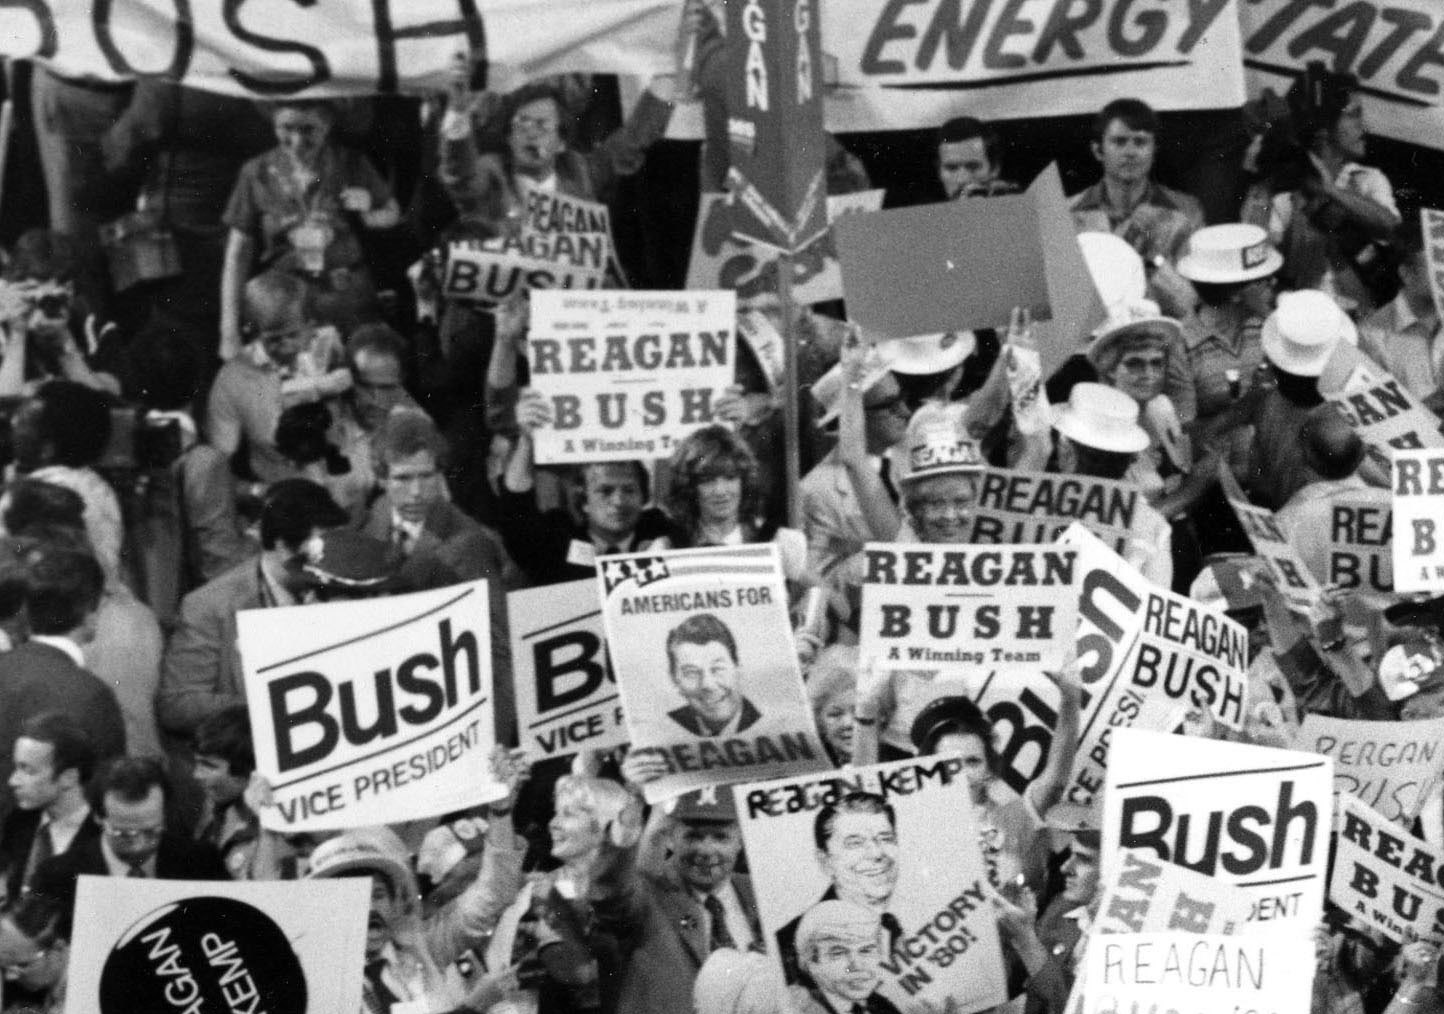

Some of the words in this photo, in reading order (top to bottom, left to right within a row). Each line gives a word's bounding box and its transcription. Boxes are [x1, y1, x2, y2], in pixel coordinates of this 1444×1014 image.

[530, 331, 730, 374] REAGAN
[551, 388, 714, 430] BUSH
[979, 472, 1138, 529] REAGAN
[866, 551, 1078, 586] REAGAN
[620, 589, 733, 615] AMERICANS
[735, 586, 773, 606] FOR
[879, 605, 1055, 639] BUSH
[1144, 592, 1247, 674] REAGAN
[887, 648, 900, 660] A
[908, 648, 985, 664] Winning
[991, 649, 1041, 662] Team
[267, 618, 482, 773] Bush
[1132, 643, 1245, 724] BUSH
[535, 713, 605, 754] VICE
[277, 784, 347, 823] VICE
[353, 719, 481, 801] PRESIDENT
[878, 759, 962, 796] KEMP
[1119, 780, 1319, 878] Bush
[880, 881, 988, 976] VICTORY
[1355, 901, 1366, 914] A
[899, 974, 932, 996] IN
[1103, 941, 1265, 990] REAGAN
